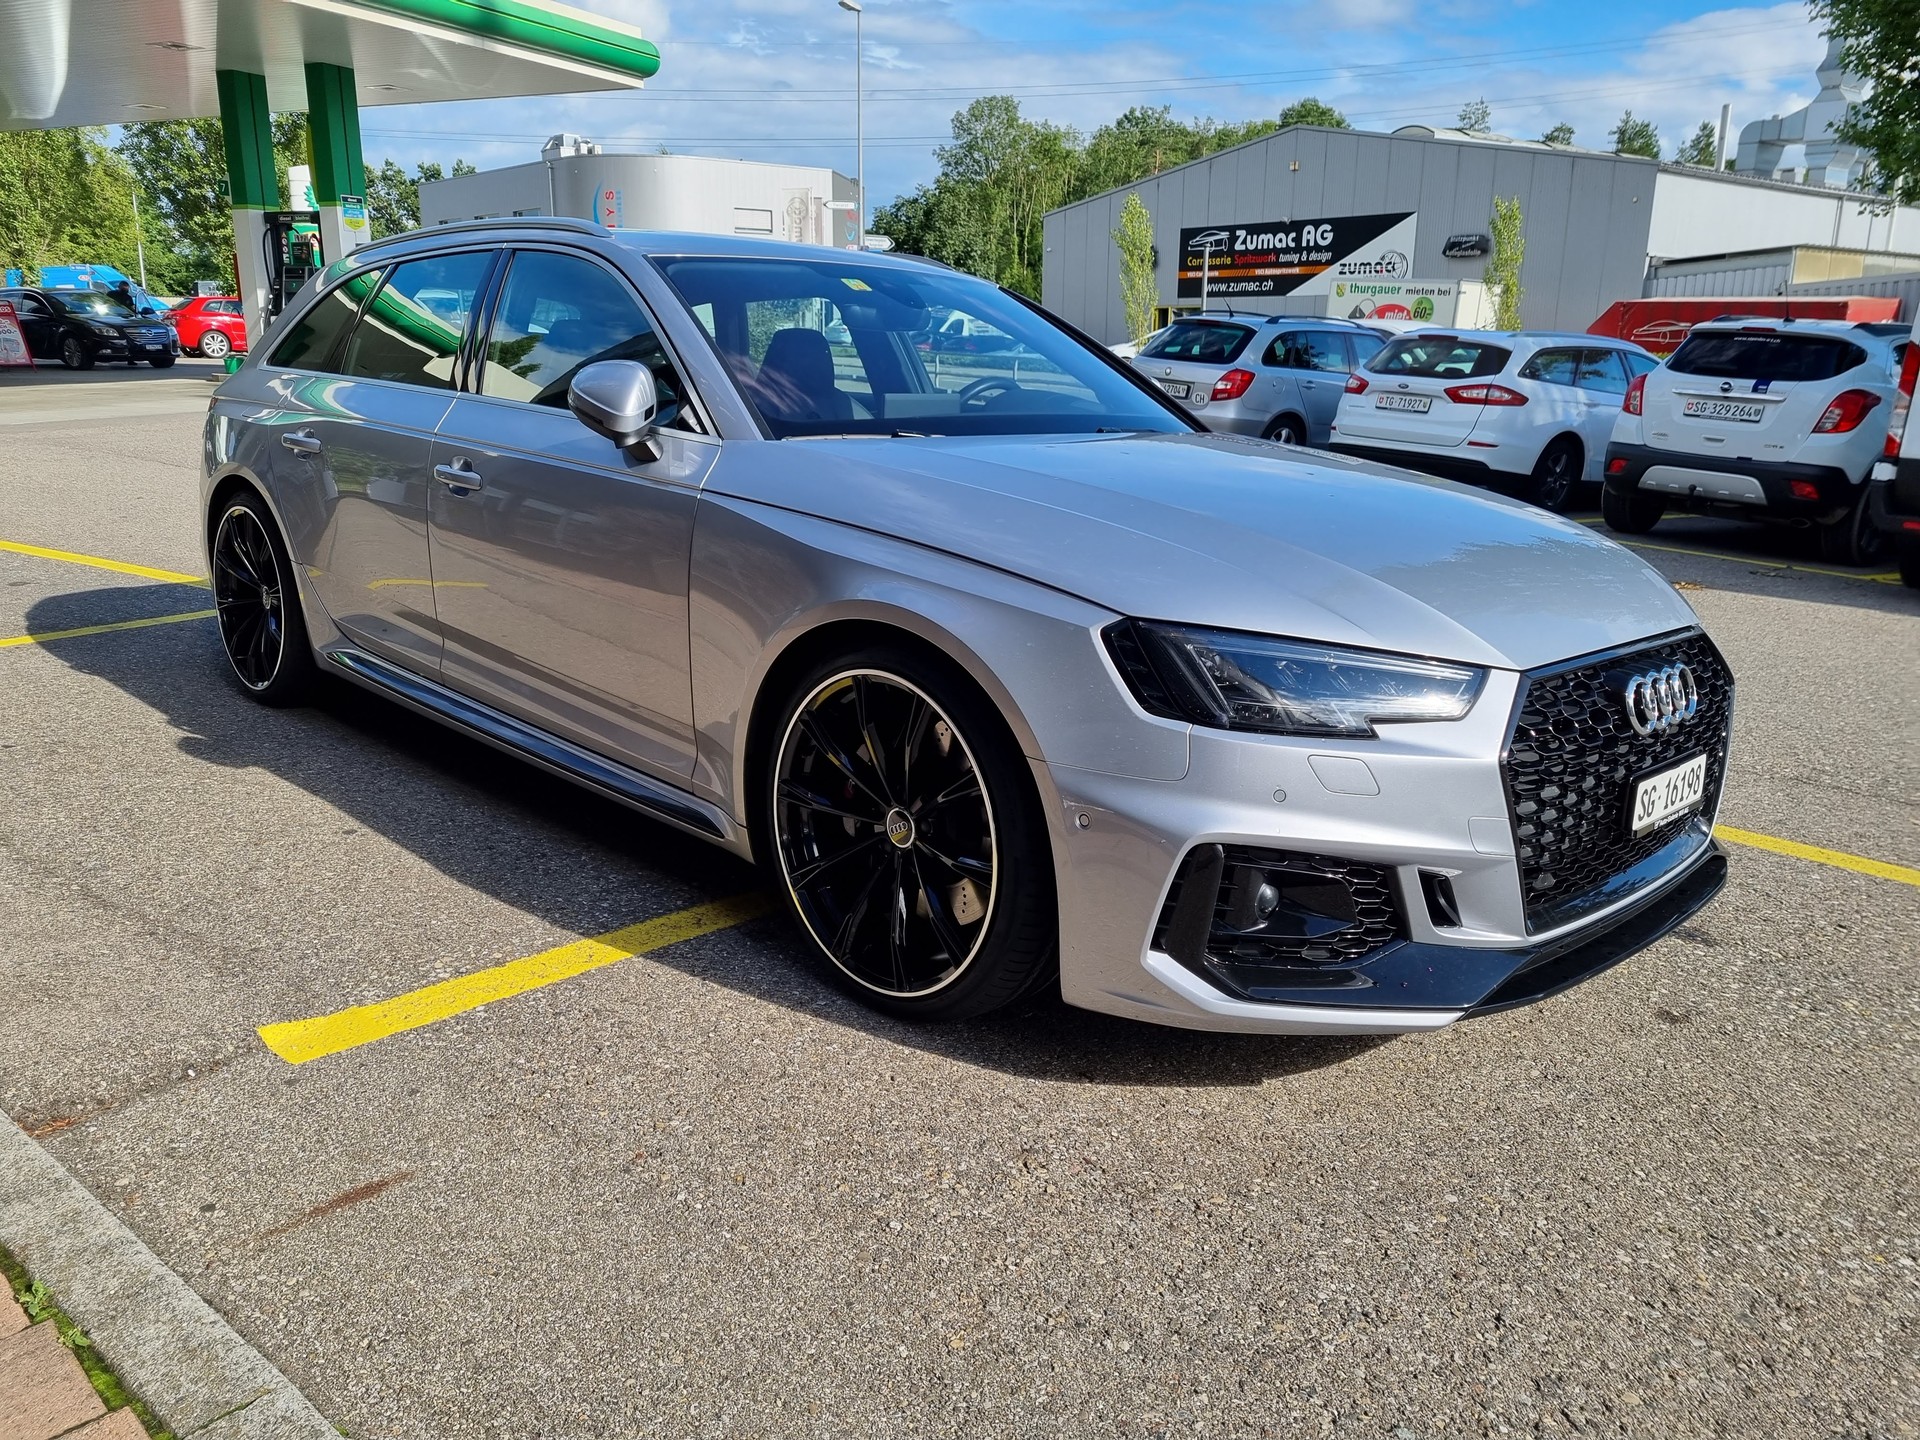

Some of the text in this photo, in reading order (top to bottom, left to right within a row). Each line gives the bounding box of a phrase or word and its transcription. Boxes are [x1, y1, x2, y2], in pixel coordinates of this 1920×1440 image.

[1234, 223, 1334, 251] Zumac AG
[1187, 249, 1332, 267] Carrsserie Spritzwerk tuning & design
[1206, 279, 1274, 293] www.zumac.ch
[1349, 283, 1451, 297] thurgauer mieten bei
[1195, 393, 1205, 404] CH
